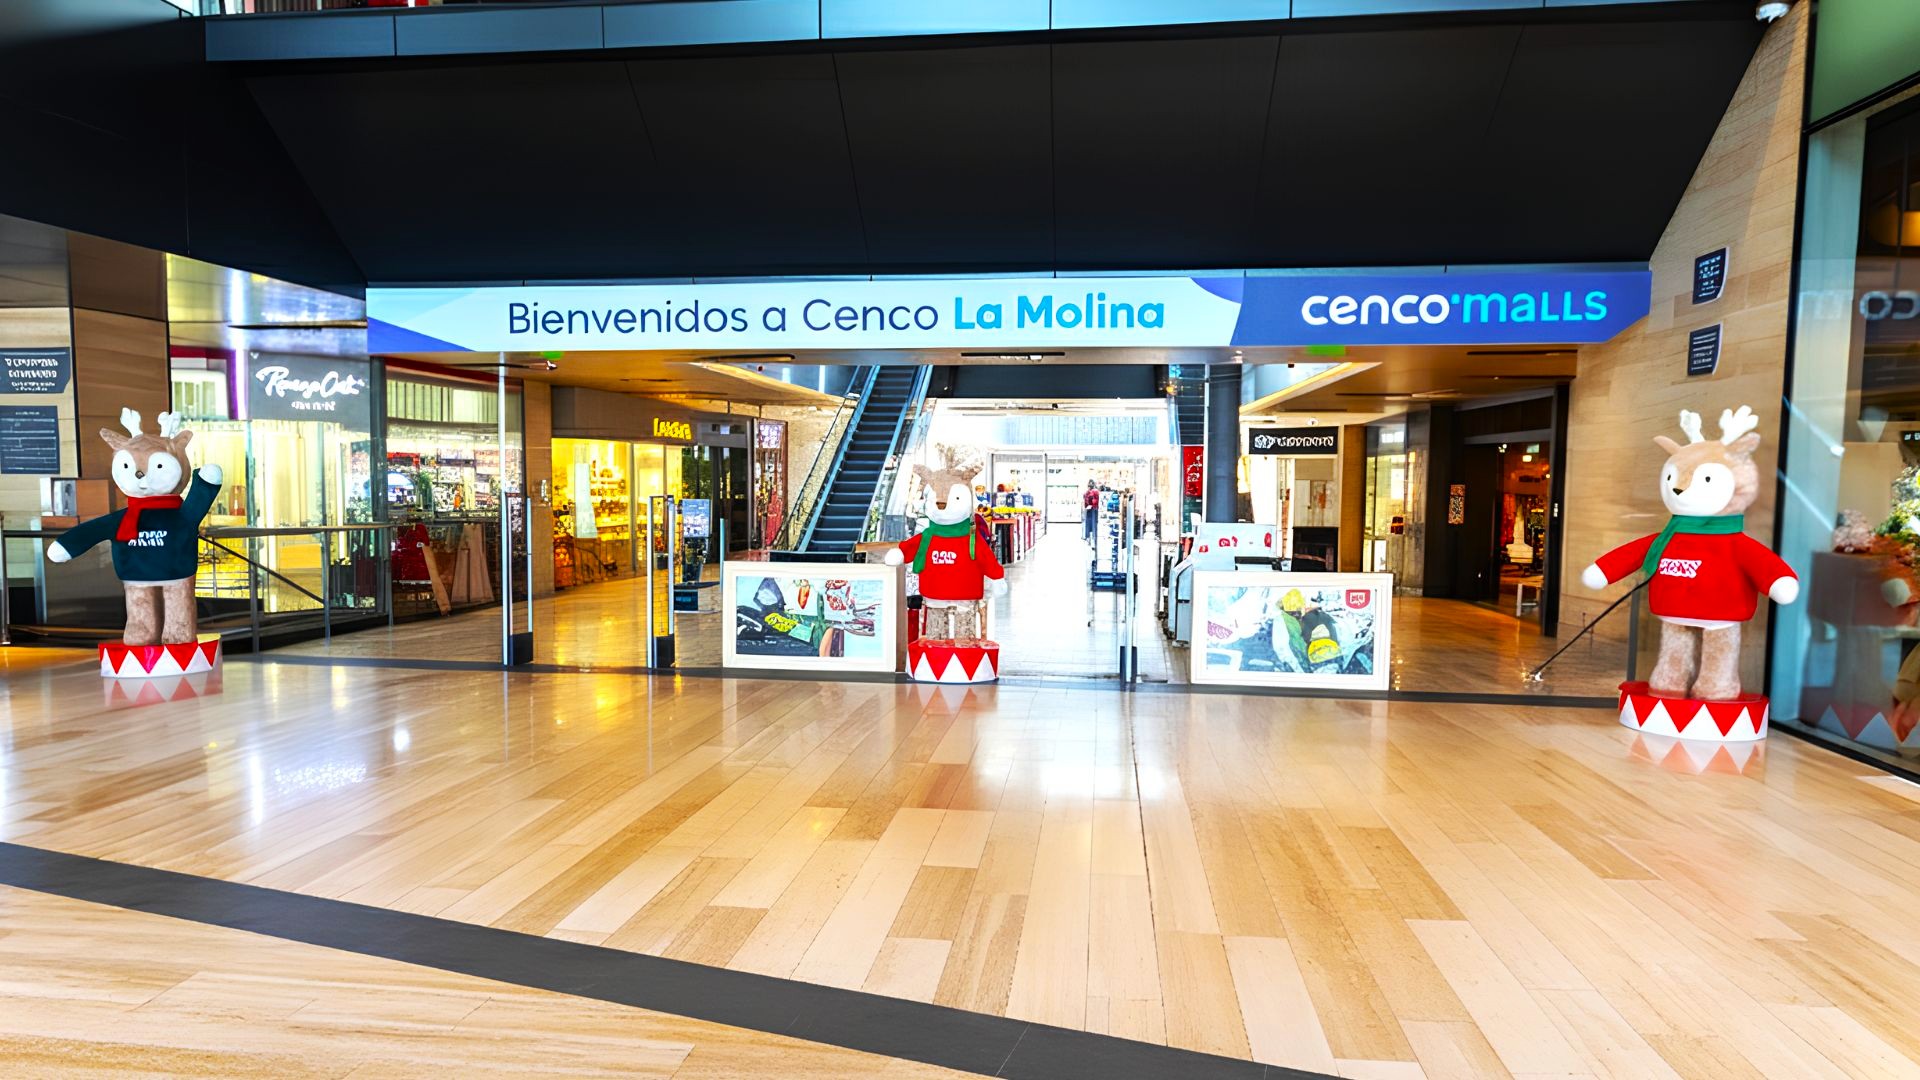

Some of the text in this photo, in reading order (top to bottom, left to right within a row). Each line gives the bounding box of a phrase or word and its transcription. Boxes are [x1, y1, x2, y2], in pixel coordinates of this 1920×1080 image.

[508, 291, 1164, 334] Bienvenidos a Cenco La Molina
